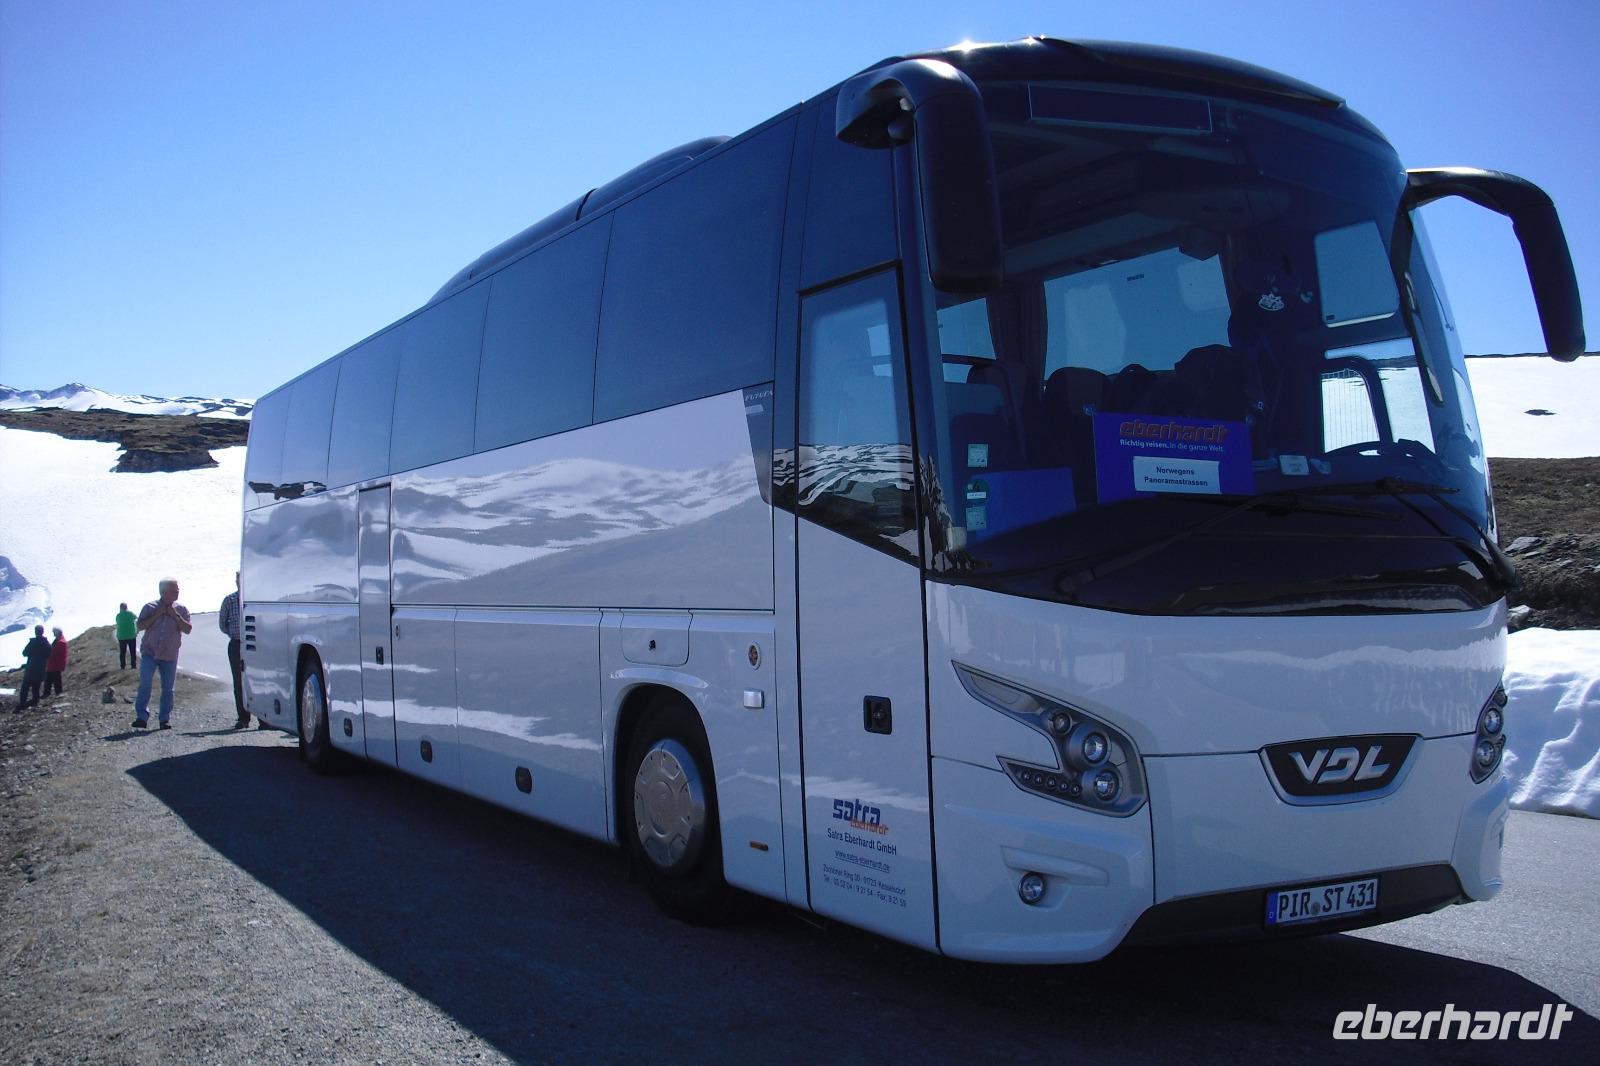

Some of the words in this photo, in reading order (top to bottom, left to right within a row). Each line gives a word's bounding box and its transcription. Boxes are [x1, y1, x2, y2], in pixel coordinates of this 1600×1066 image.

[1120, 419, 1227, 443] eberhardt
[1120, 439, 1144, 448] Richtig
[1189, 444, 1207, 452] ganze
[1144, 476, 1208, 487] Panoramastrassen
[1156, 466, 1194, 476] Norwegens
[1288, 745, 1391, 784] VDL
[833, 799, 880, 825] satra
[827, 828, 843, 841] Satra
[845, 832, 876, 850] Eberhardt
[877, 841, 897, 856] GmbH
[1278, 891, 1311, 919] PIR
[1322, 887, 1344, 913] ST
[1346, 882, 1375, 908] 431
